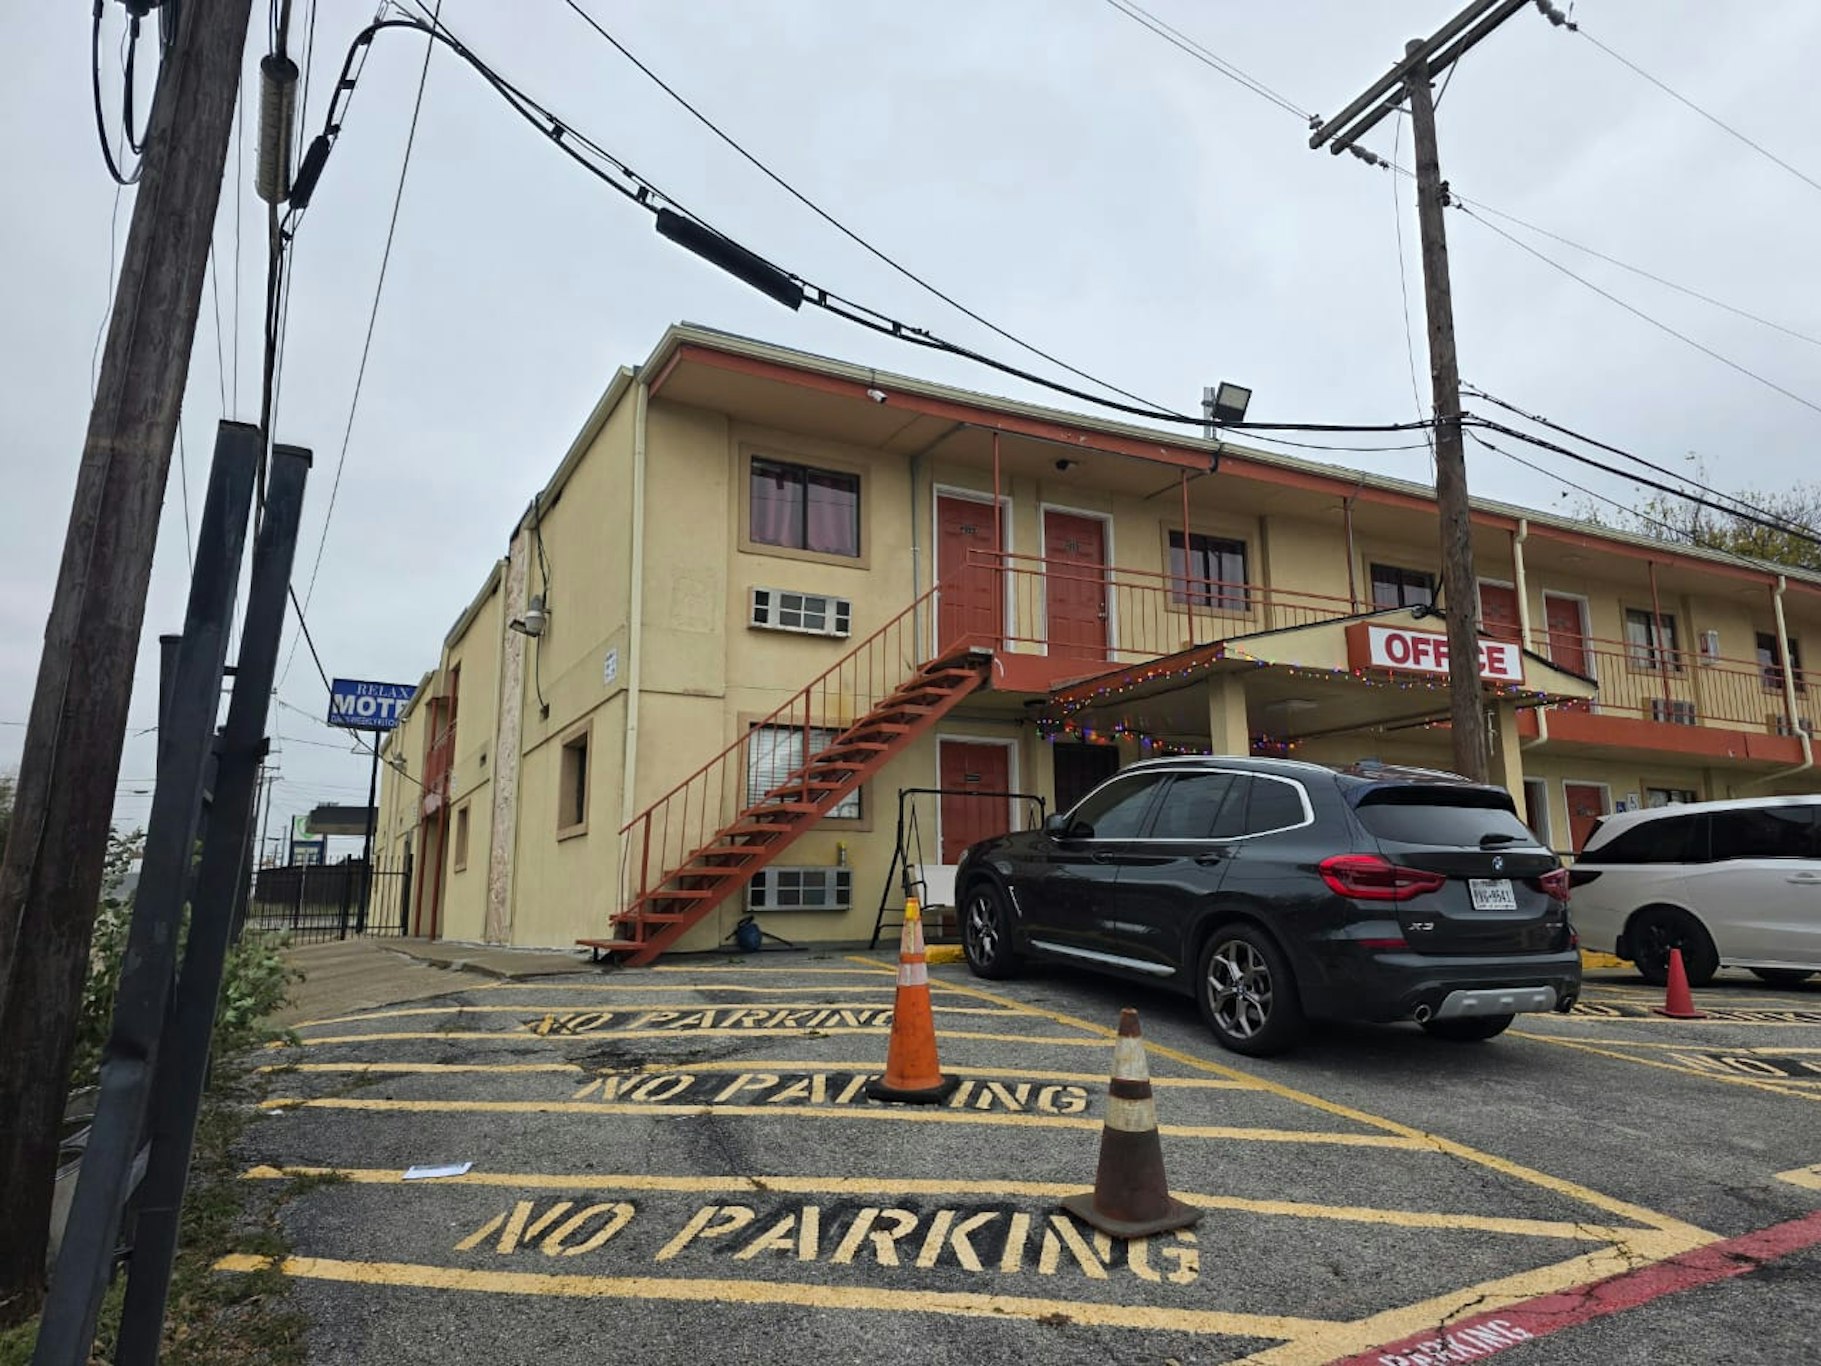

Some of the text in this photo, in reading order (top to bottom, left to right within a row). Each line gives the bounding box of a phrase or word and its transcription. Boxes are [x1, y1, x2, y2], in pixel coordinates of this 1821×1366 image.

[1385, 632, 1508, 675] OFFE
[331, 693, 411, 718] MOTE
[356, 683, 411, 699] RELAX
[513, 1012, 614, 1035] NO
[571, 1073, 1088, 1114] NO PAING
[454, 1201, 1201, 1285] NO PARKING
